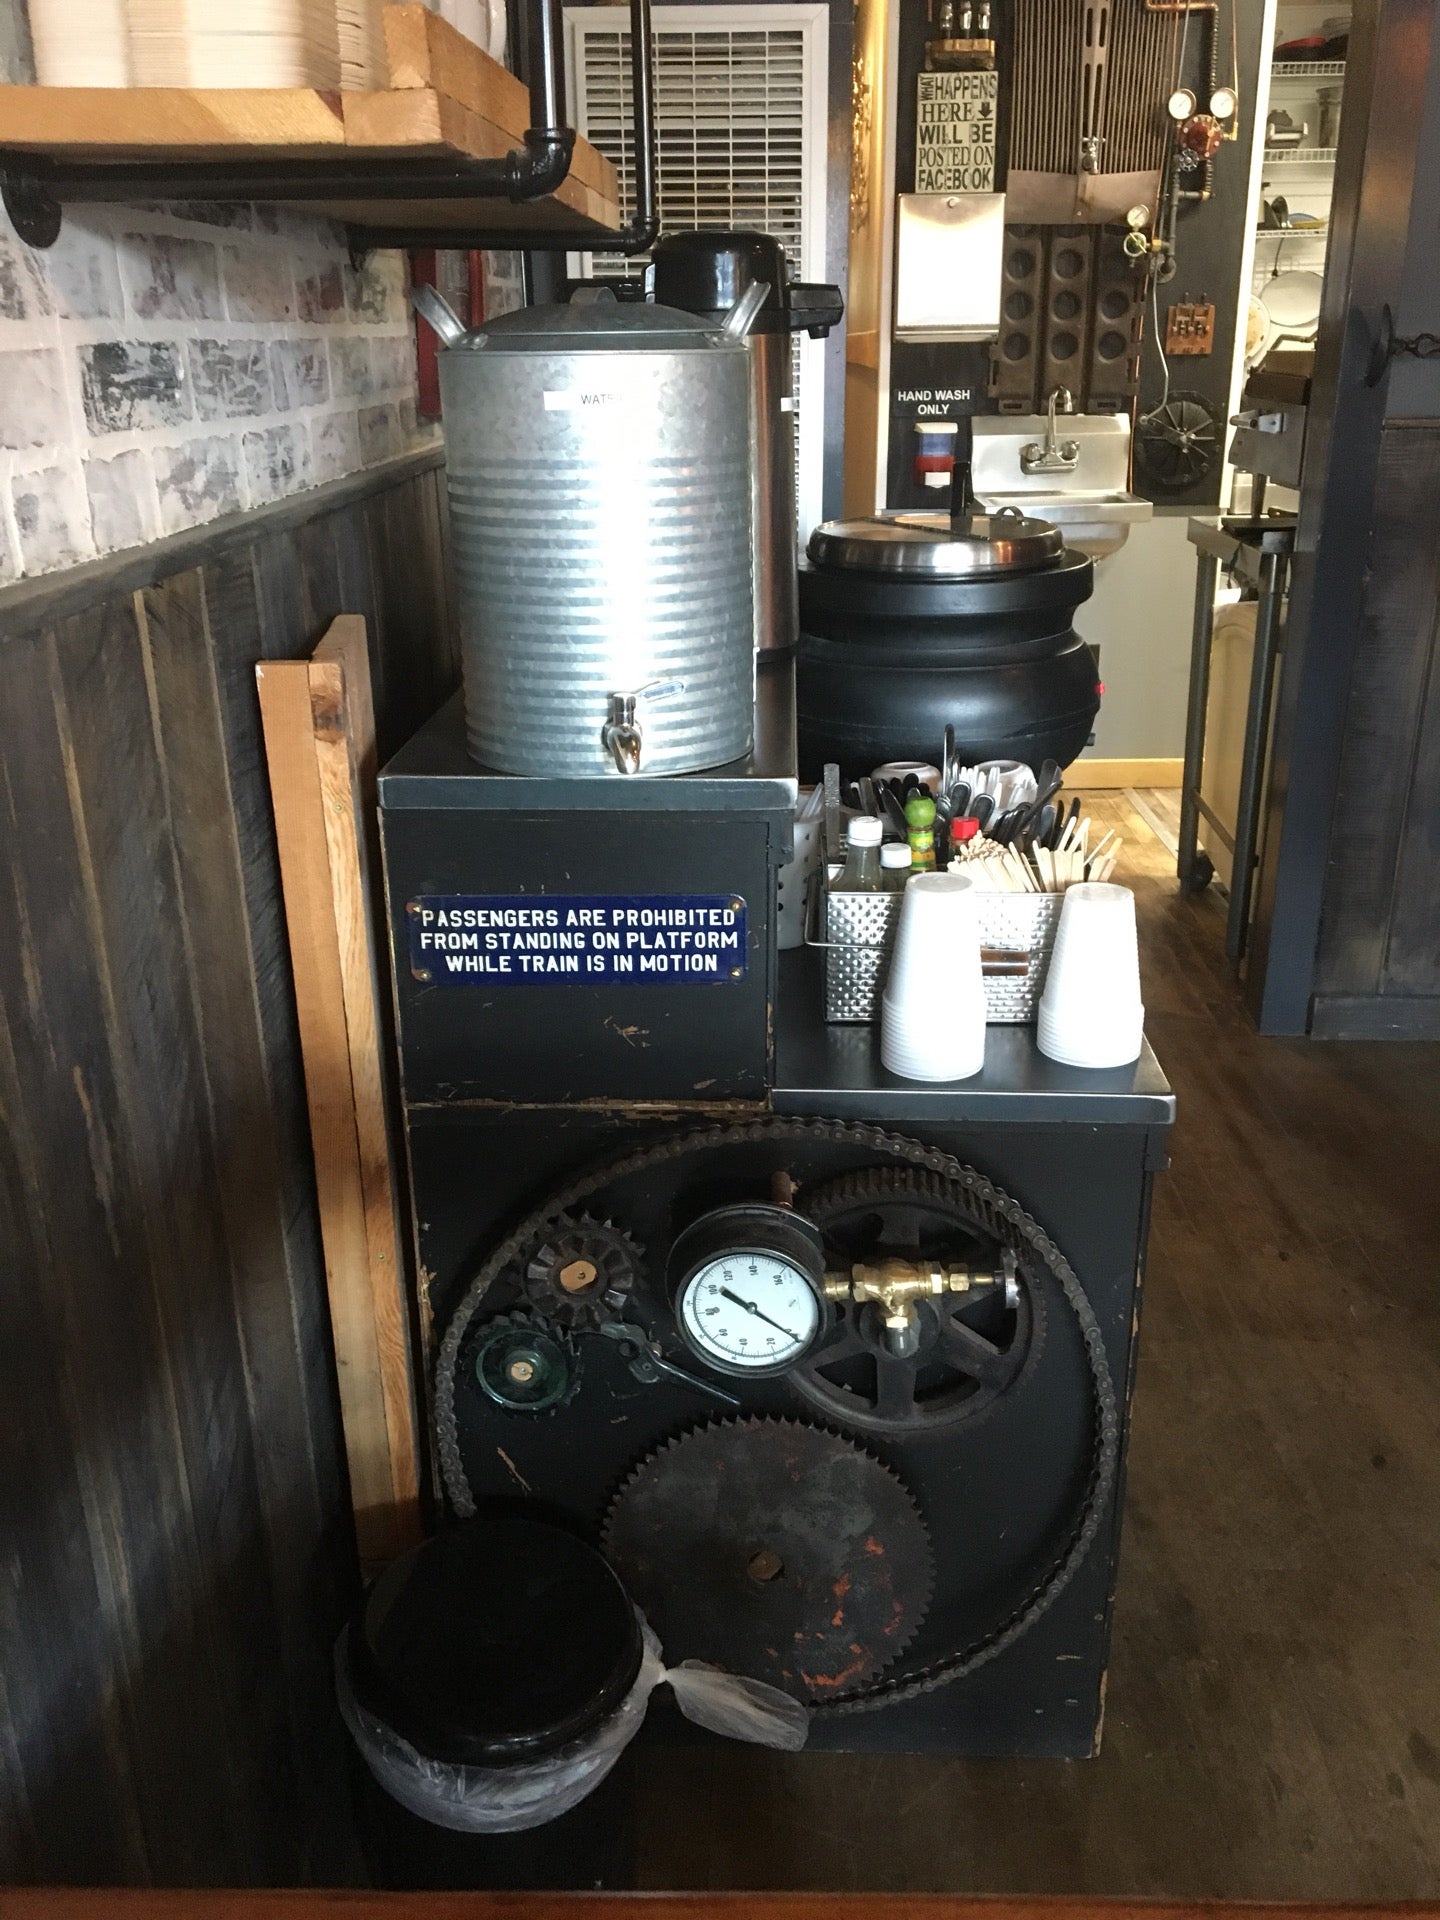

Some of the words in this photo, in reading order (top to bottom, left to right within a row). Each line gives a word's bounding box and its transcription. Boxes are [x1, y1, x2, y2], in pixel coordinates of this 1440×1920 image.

[920, 76, 934, 101] WHAT
[935, 75, 997, 100] HAPPENS
[921, 102, 975, 122] HERE
[919, 124, 963, 145] WILL
[970, 123, 993, 143] BE
[918, 146, 971, 168] POSTED
[974, 146, 995, 166] ON
[918, 167, 992, 191] FACEBOOK
[898, 390, 932, 401] HAND
[935, 389, 970, 400] WASH
[917, 404, 950, 415] ONLY
[422, 909, 559, 928] PASSENGERS
[566, 909, 607, 927] ARE
[613, 908, 736, 927] PROHIBITED
[421, 932, 479, 950] FROM
[485, 931, 586, 949] STANDING
[592, 931, 620, 949] ON
[626, 931, 738, 949] PLATFORM
[445, 955, 512, 973] WHILE
[519, 955, 579, 972] TRAIN
[587, 955, 605, 972] IS
[614, 955, 633, 972] IN
[640, 954, 718, 972] MOTION
[723, 1270, 734, 1281] 120
[748, 1265, 759, 1276] 140
[773, 1274, 784, 1286] 160
[708, 1284, 718, 1295] 100
[719, 1328, 728, 1336] 60
[739, 1338, 748, 1346] 40
[766, 1337, 775, 1345] 20
